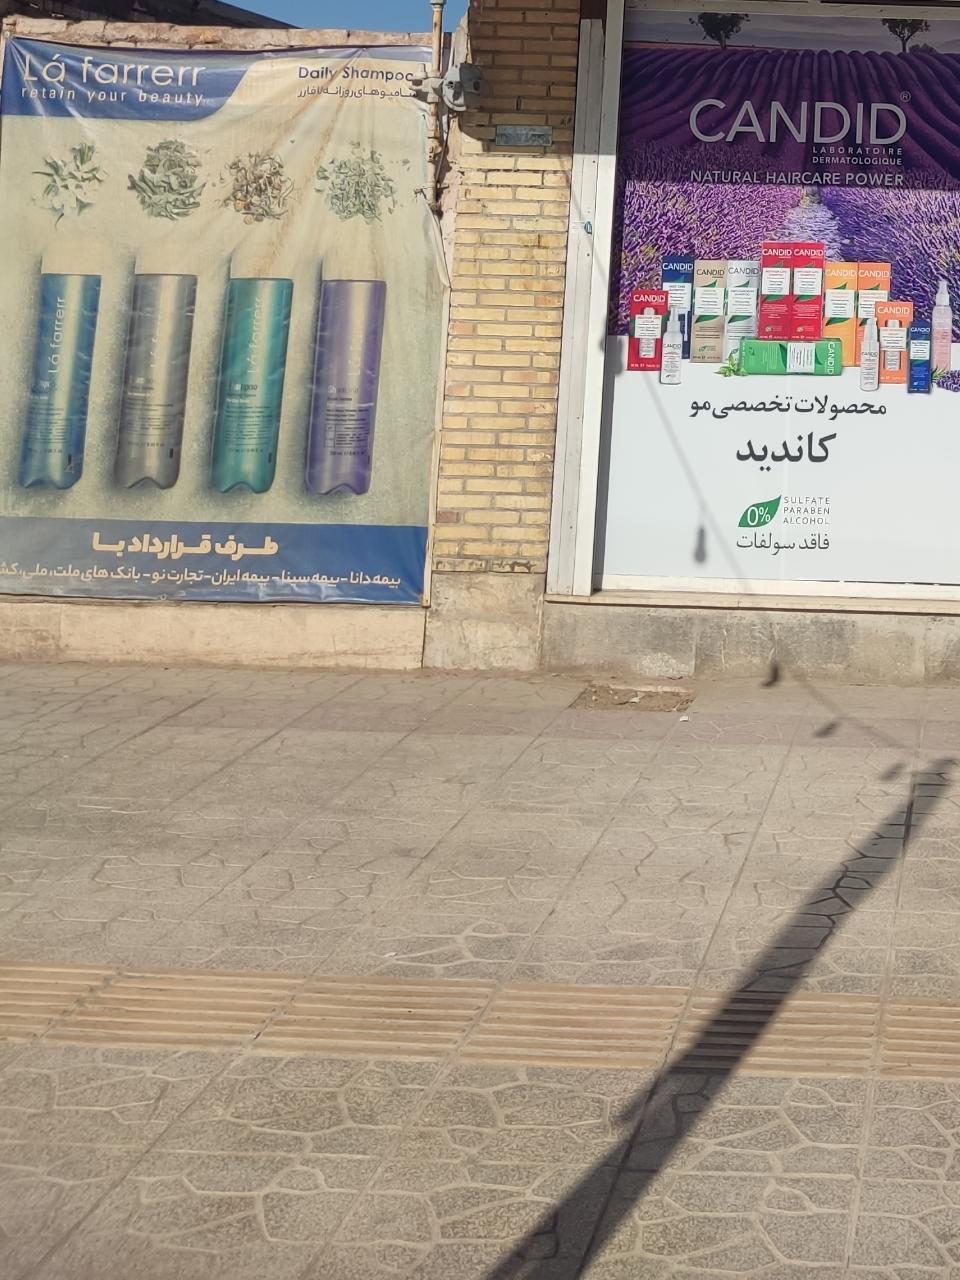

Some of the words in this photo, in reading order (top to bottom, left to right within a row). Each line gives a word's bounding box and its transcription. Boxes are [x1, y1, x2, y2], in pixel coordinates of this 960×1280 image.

[24, 53, 66, 82] Lá
[82, 56, 206, 87] farrerr
[298, 66, 340, 81] Daily
[21, 87, 76, 100] retain
[87, 91, 127, 103] your
[812, 146, 903, 156] LABORATOIRE
[812, 156, 903, 166] DERMATOLOGIQUE
[690, 169, 761, 184] NATURAL
[766, 171, 841, 185] HAIRCARE
[845, 172, 904, 186] POWER
[662, 262, 694, 271] CANDID
[697, 268, 725, 276] CANDID
[633, 294, 666, 303] CANDID
[877, 307, 910, 315] CANDID
[689, 399, 712, 418] مو
[712, 396, 793, 419] تخصصی
[795, 394, 887, 420] محصولات
[736, 431, 837, 472] کاندید
[783, 496, 831, 505] SULFATE
[747, 506, 771, 526] 0%
[783, 507, 830, 515] PARABEN
[782, 517, 830, 525] ALCOHOL
[92, 531, 126, 557] با
[128, 533, 212, 560] قرارداد
[215, 535, 279, 561] طرف
[736, 532, 796, 556] سولفات
[798, 533, 830, 550] فاقد
